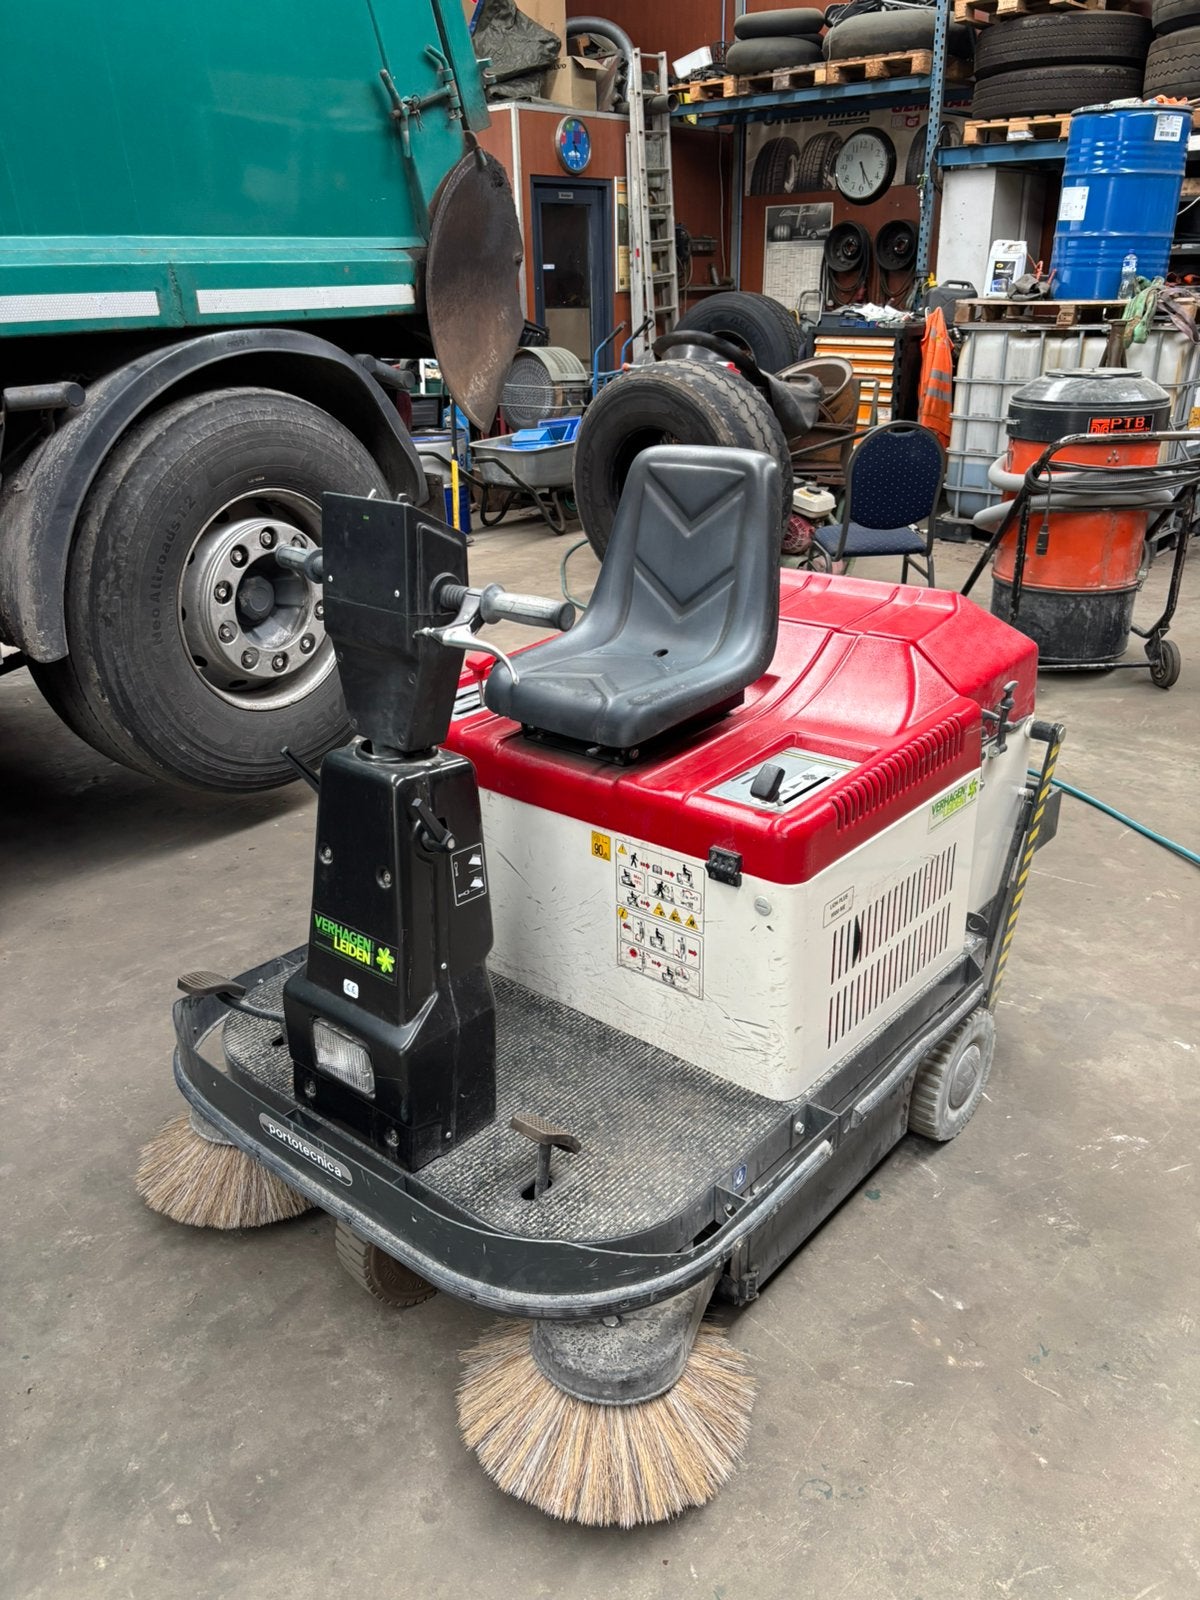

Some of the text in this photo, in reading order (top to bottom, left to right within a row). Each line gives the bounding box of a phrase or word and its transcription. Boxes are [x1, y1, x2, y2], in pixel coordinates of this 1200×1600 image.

[1110, 416, 1145, 429] PTB
[931, 786, 966, 815] VERHAGEN
[594, 842, 604, 856] 90
[315, 913, 371, 952] VERHAGEN
[334, 936, 371, 965] LEIDEN
[268, 1123, 343, 1178] portotecnica
